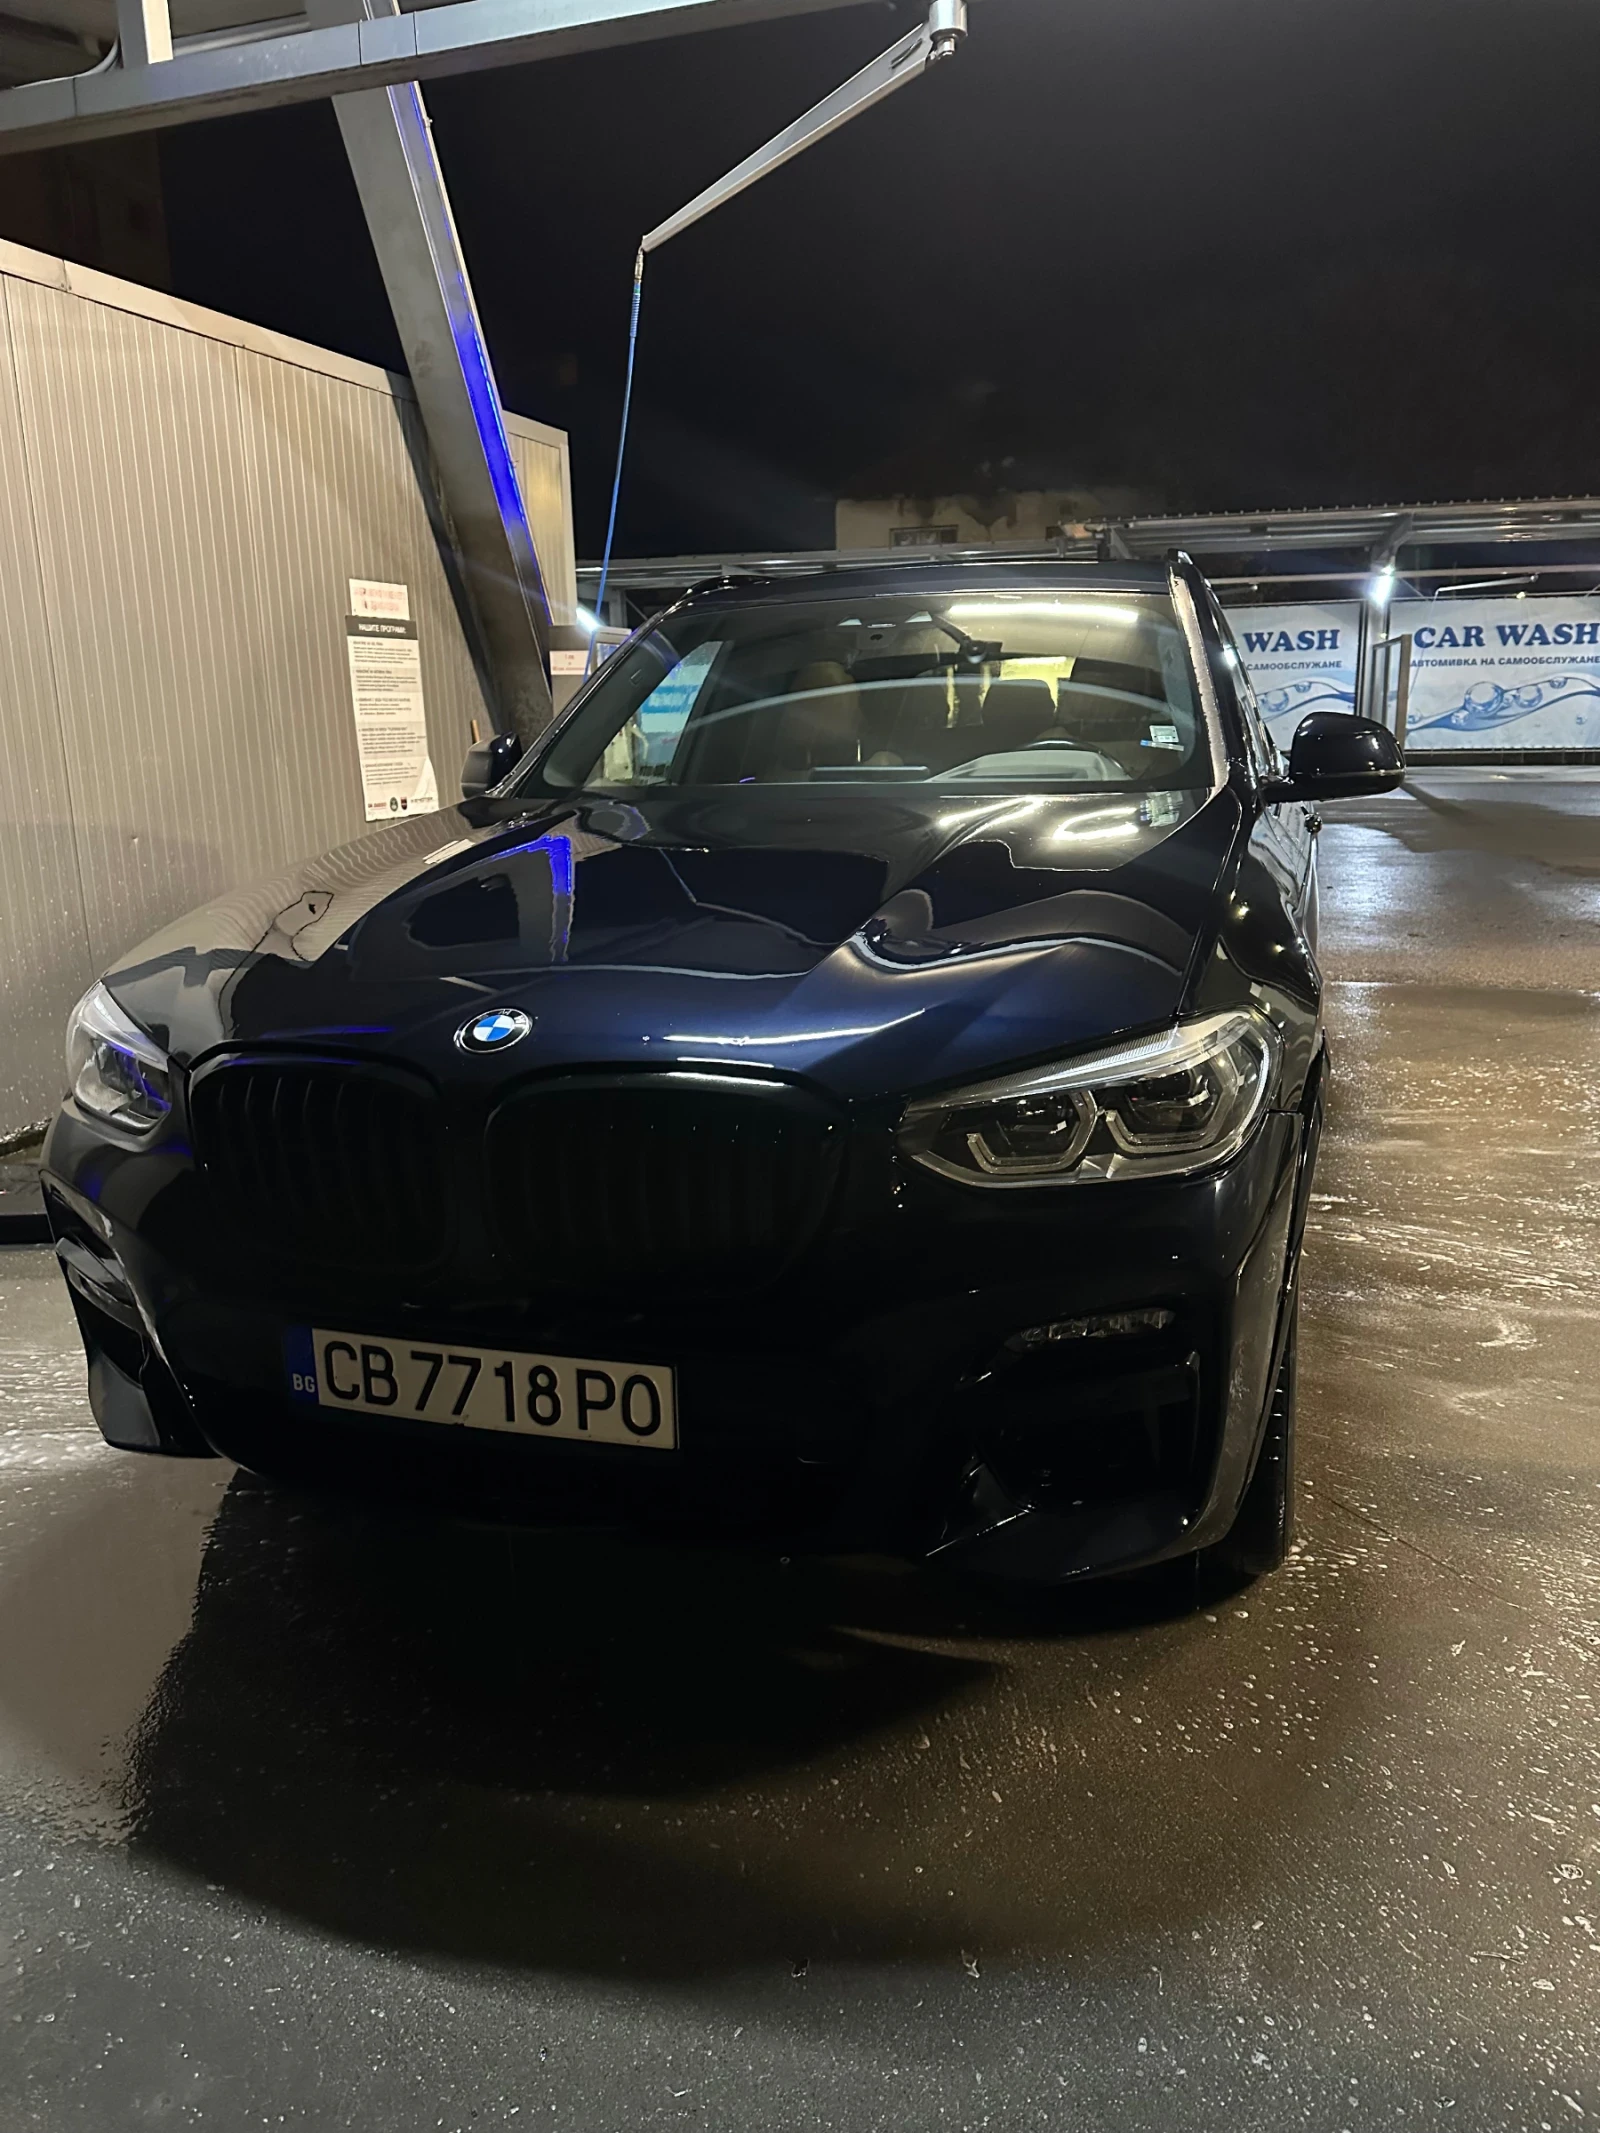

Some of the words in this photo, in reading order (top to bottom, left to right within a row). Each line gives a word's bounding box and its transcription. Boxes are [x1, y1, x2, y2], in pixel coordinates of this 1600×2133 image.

[1242, 629, 1340, 653] WASH
[1414, 625, 1486, 648] CAR
[1495, 623, 1600, 646] WASH
[1246, 660, 1342, 672] САМООБСЛУЖАНЕ
[1410, 658, 1477, 667] АВТОМИВКА
[1482, 657, 1496, 665] НА
[1498, 655, 1600, 665] САМООБСЛУЖАНЕ
[292, 1373, 315, 1393] BG
